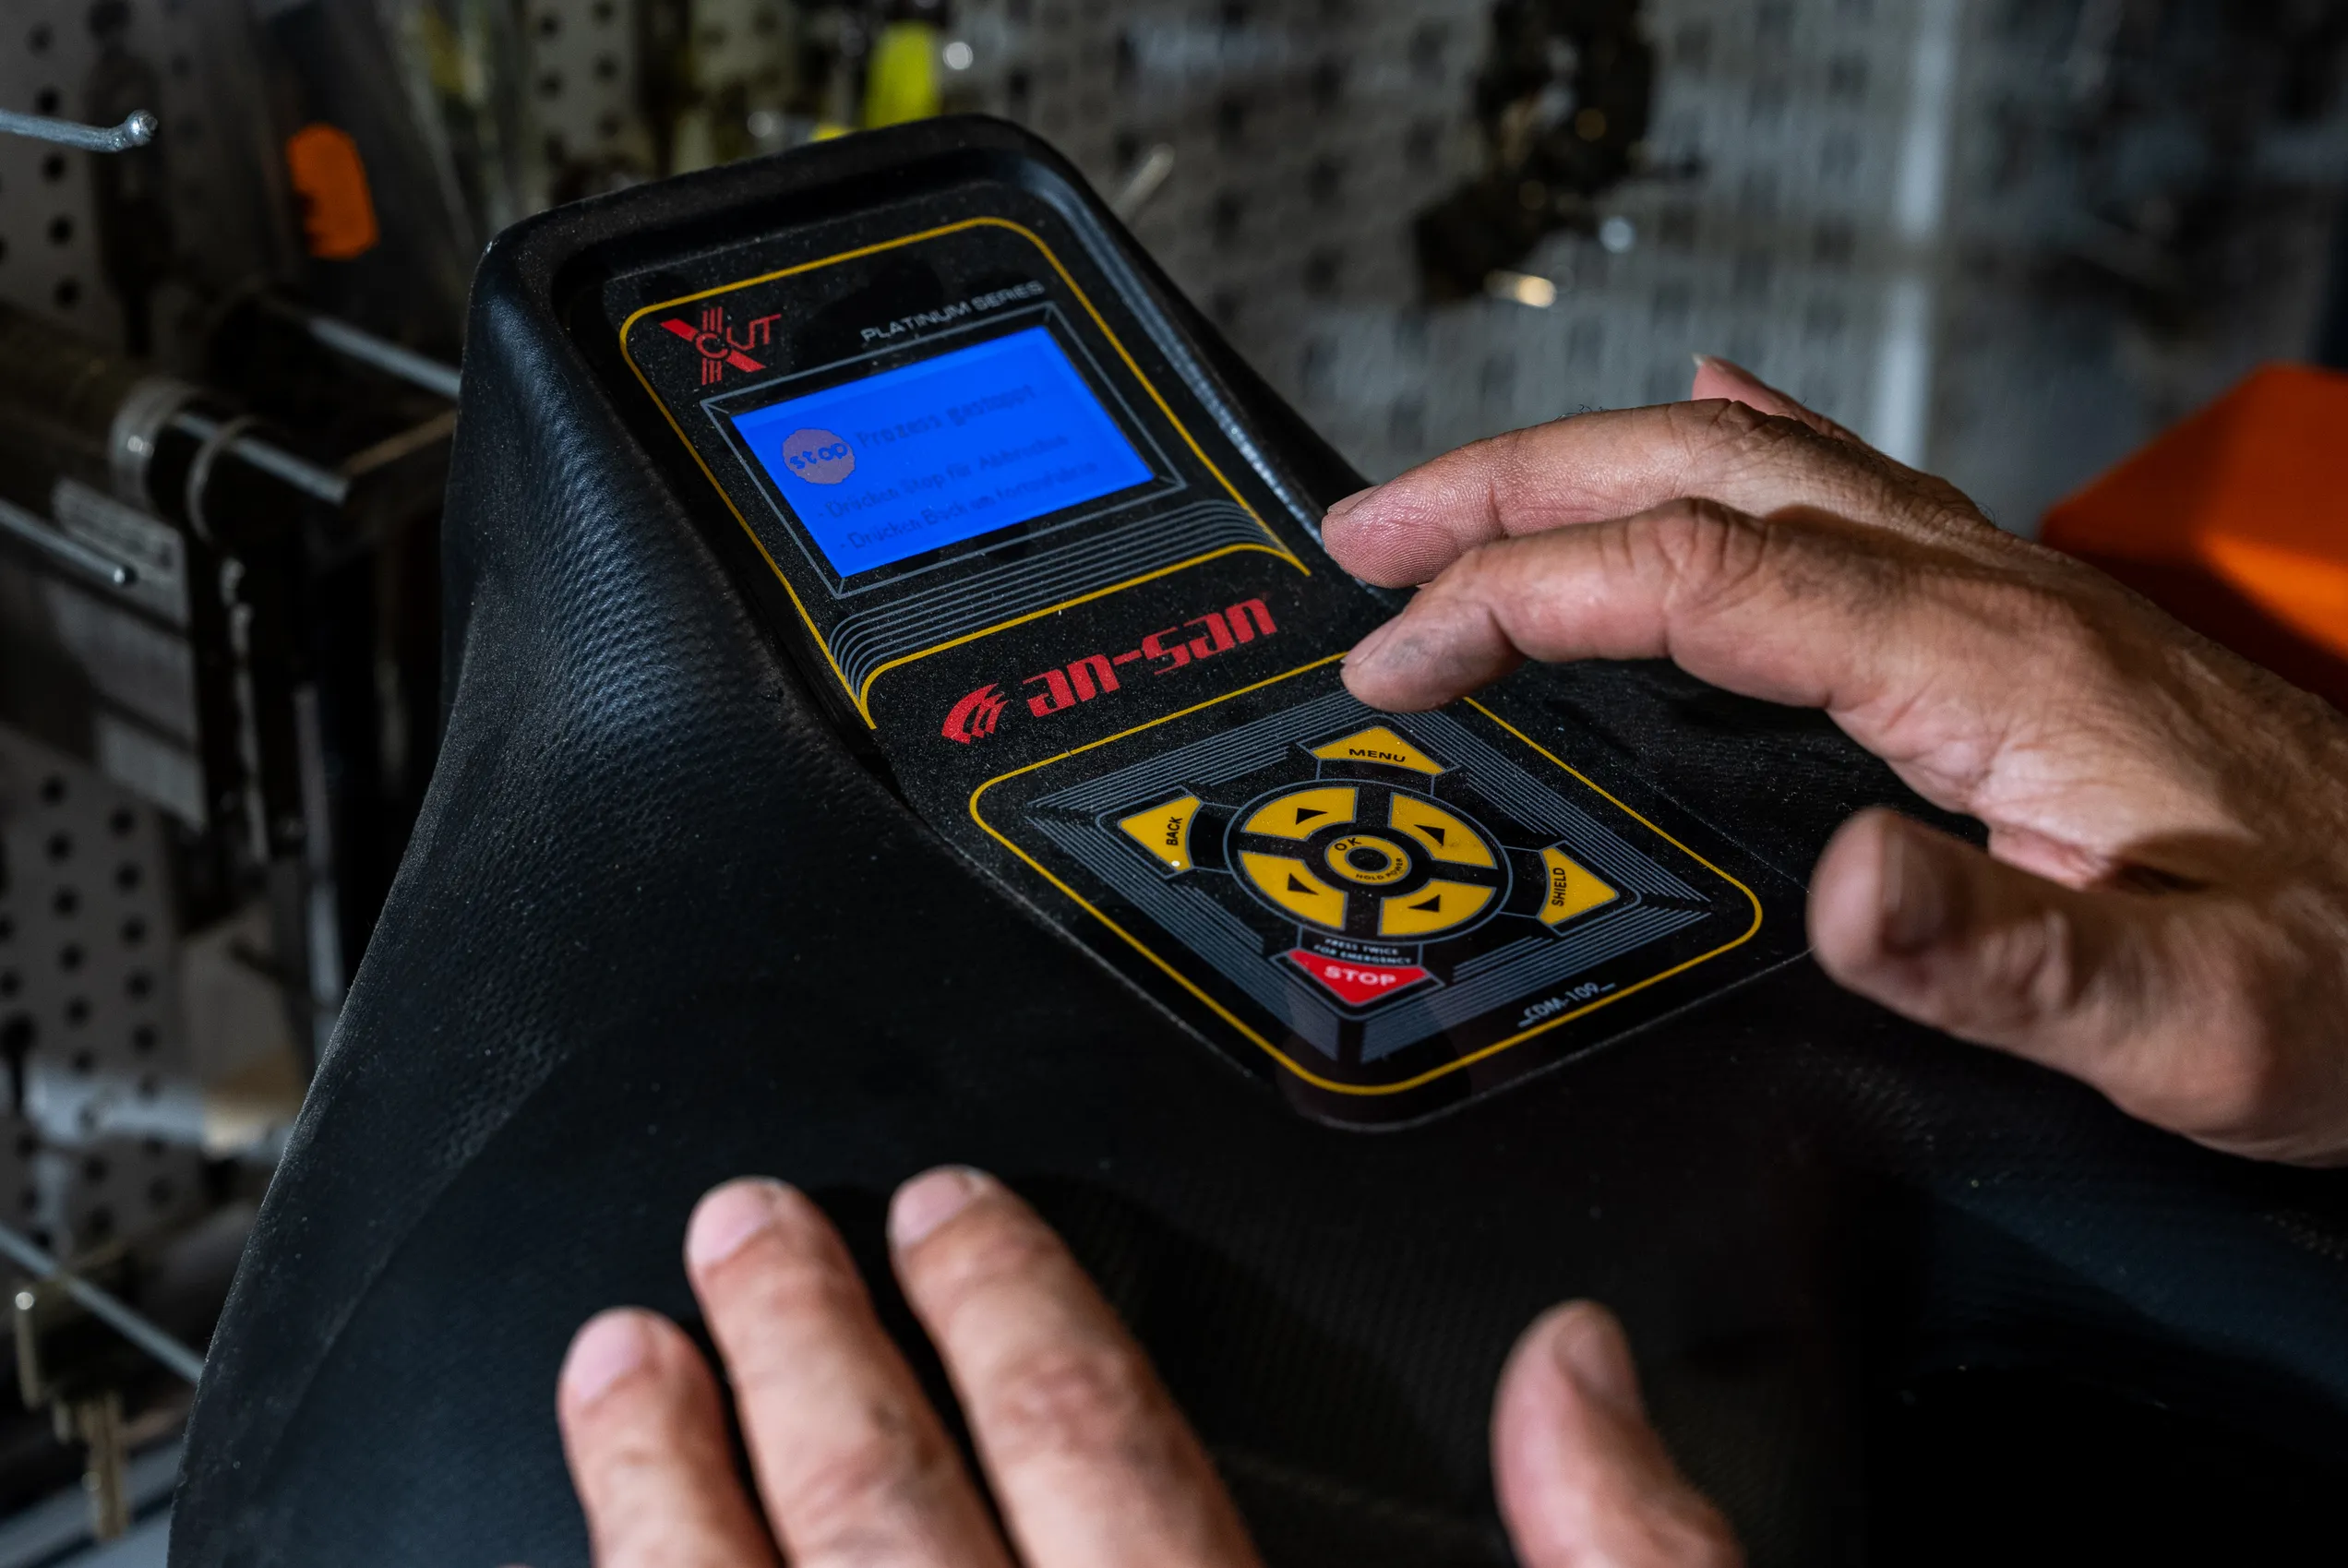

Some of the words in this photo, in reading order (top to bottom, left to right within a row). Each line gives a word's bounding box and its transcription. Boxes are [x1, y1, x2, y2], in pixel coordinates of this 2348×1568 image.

[860, 301, 972, 341] PLATINUM
[971, 280, 1045, 312] SERIES
[856, 414, 943, 449] Prozess
[1023, 597, 1277, 718] an-san
[1348, 748, 1406, 763] MENU
[1166, 816, 1183, 846] BACK
[1334, 837, 1362, 852] OK
[1385, 857, 1404, 878] POWER
[1551, 868, 1567, 907] SHIELD
[1313, 944, 1337, 956] FOR
[1340, 951, 1411, 964] EMERGENCY
[1324, 938, 1359, 952] PRESS
[1362, 945, 1399, 956] TWICE
[1324, 964, 1396, 987] STOP
